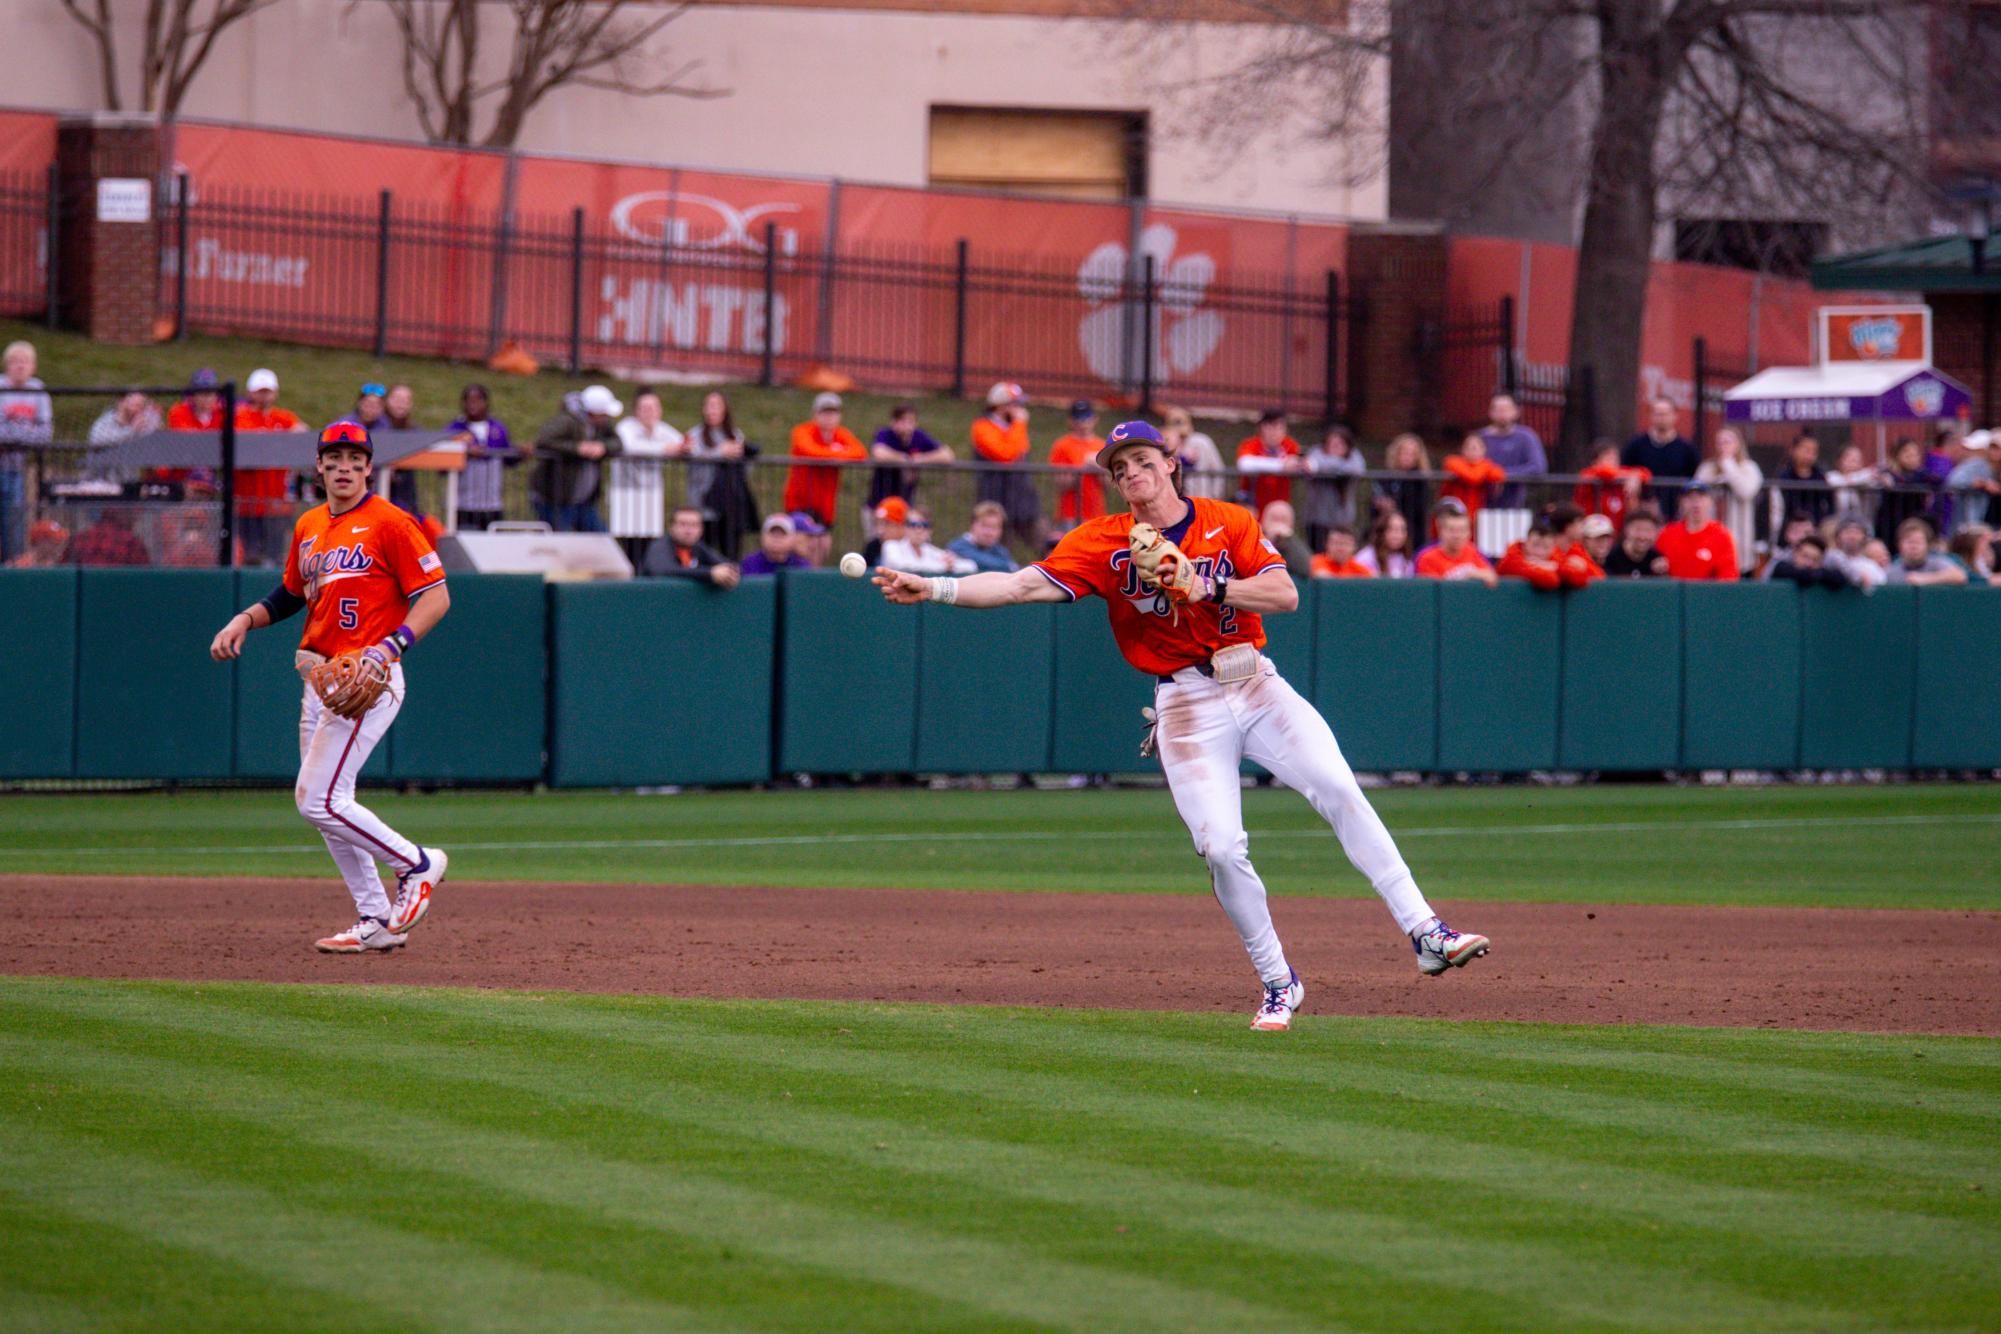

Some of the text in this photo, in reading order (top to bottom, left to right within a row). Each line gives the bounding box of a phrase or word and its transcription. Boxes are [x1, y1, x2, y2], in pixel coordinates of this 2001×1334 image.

[599, 275, 789, 356] HNTB
[1111, 424, 1128, 442] C
[299, 534, 372, 600] Tigers
[339, 598, 359, 630] 5
[1219, 604, 1237, 636] 2
